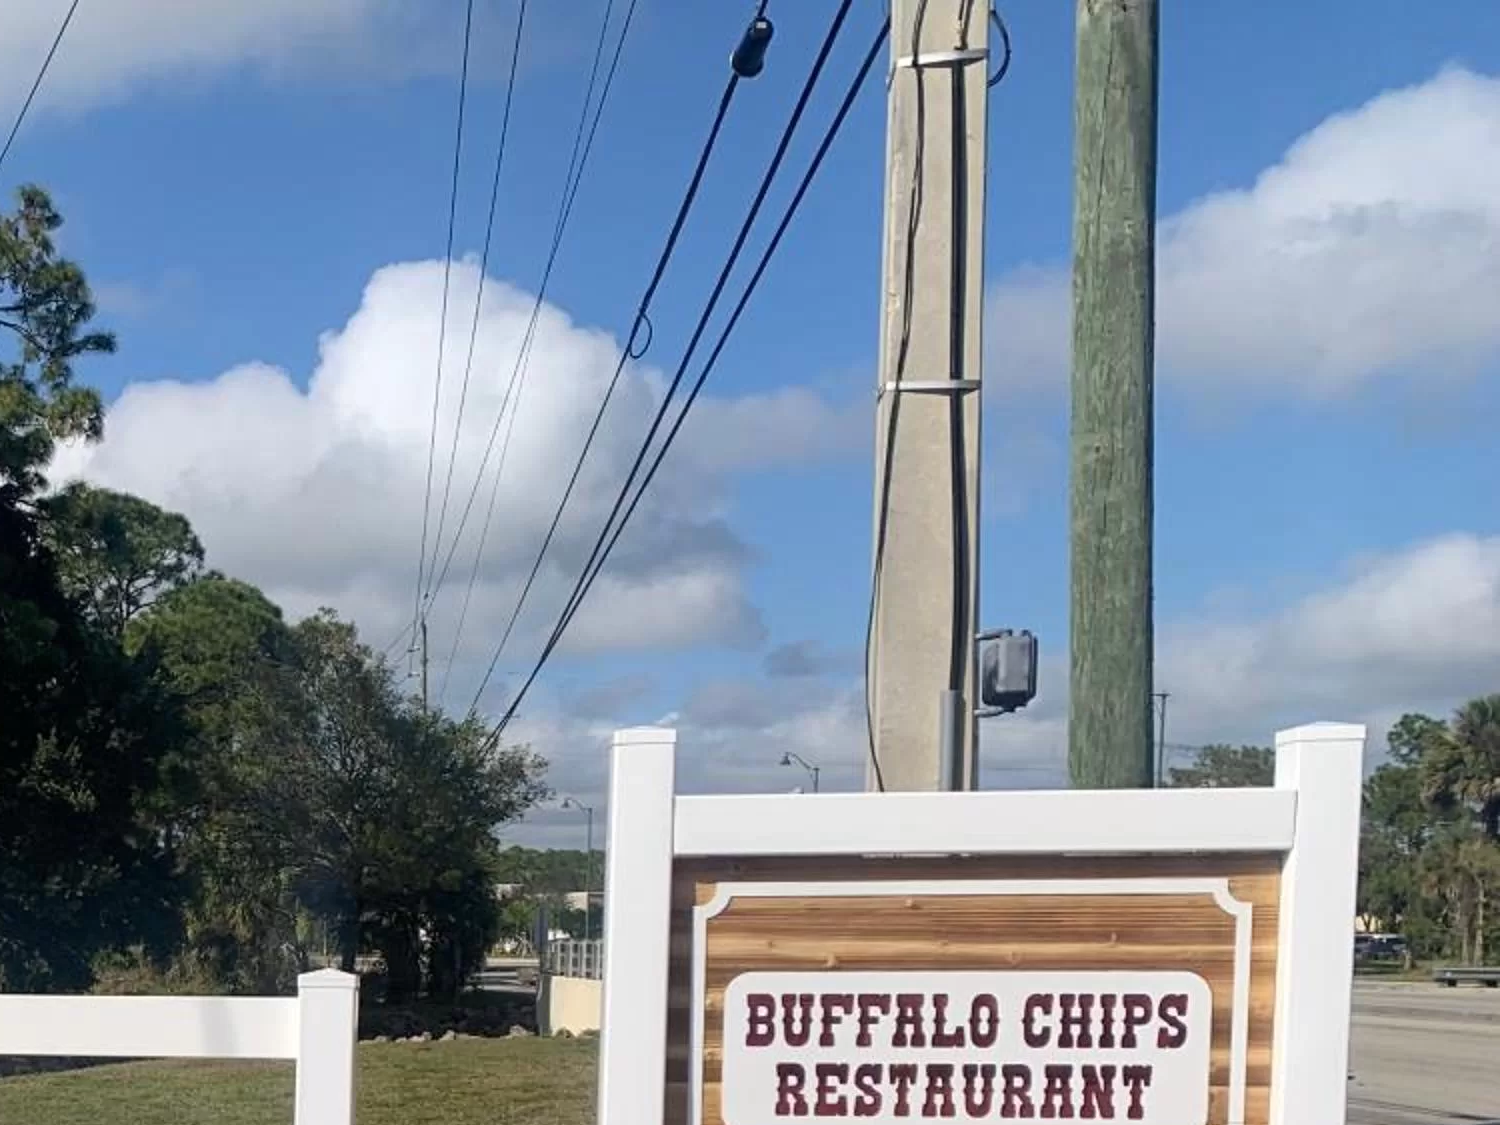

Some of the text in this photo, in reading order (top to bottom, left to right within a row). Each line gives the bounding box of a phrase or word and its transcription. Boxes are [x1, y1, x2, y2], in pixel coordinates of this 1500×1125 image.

[745, 993, 1190, 1049] BUFFALO CHIPS
[774, 1063, 1154, 1119] RESTAURANT
